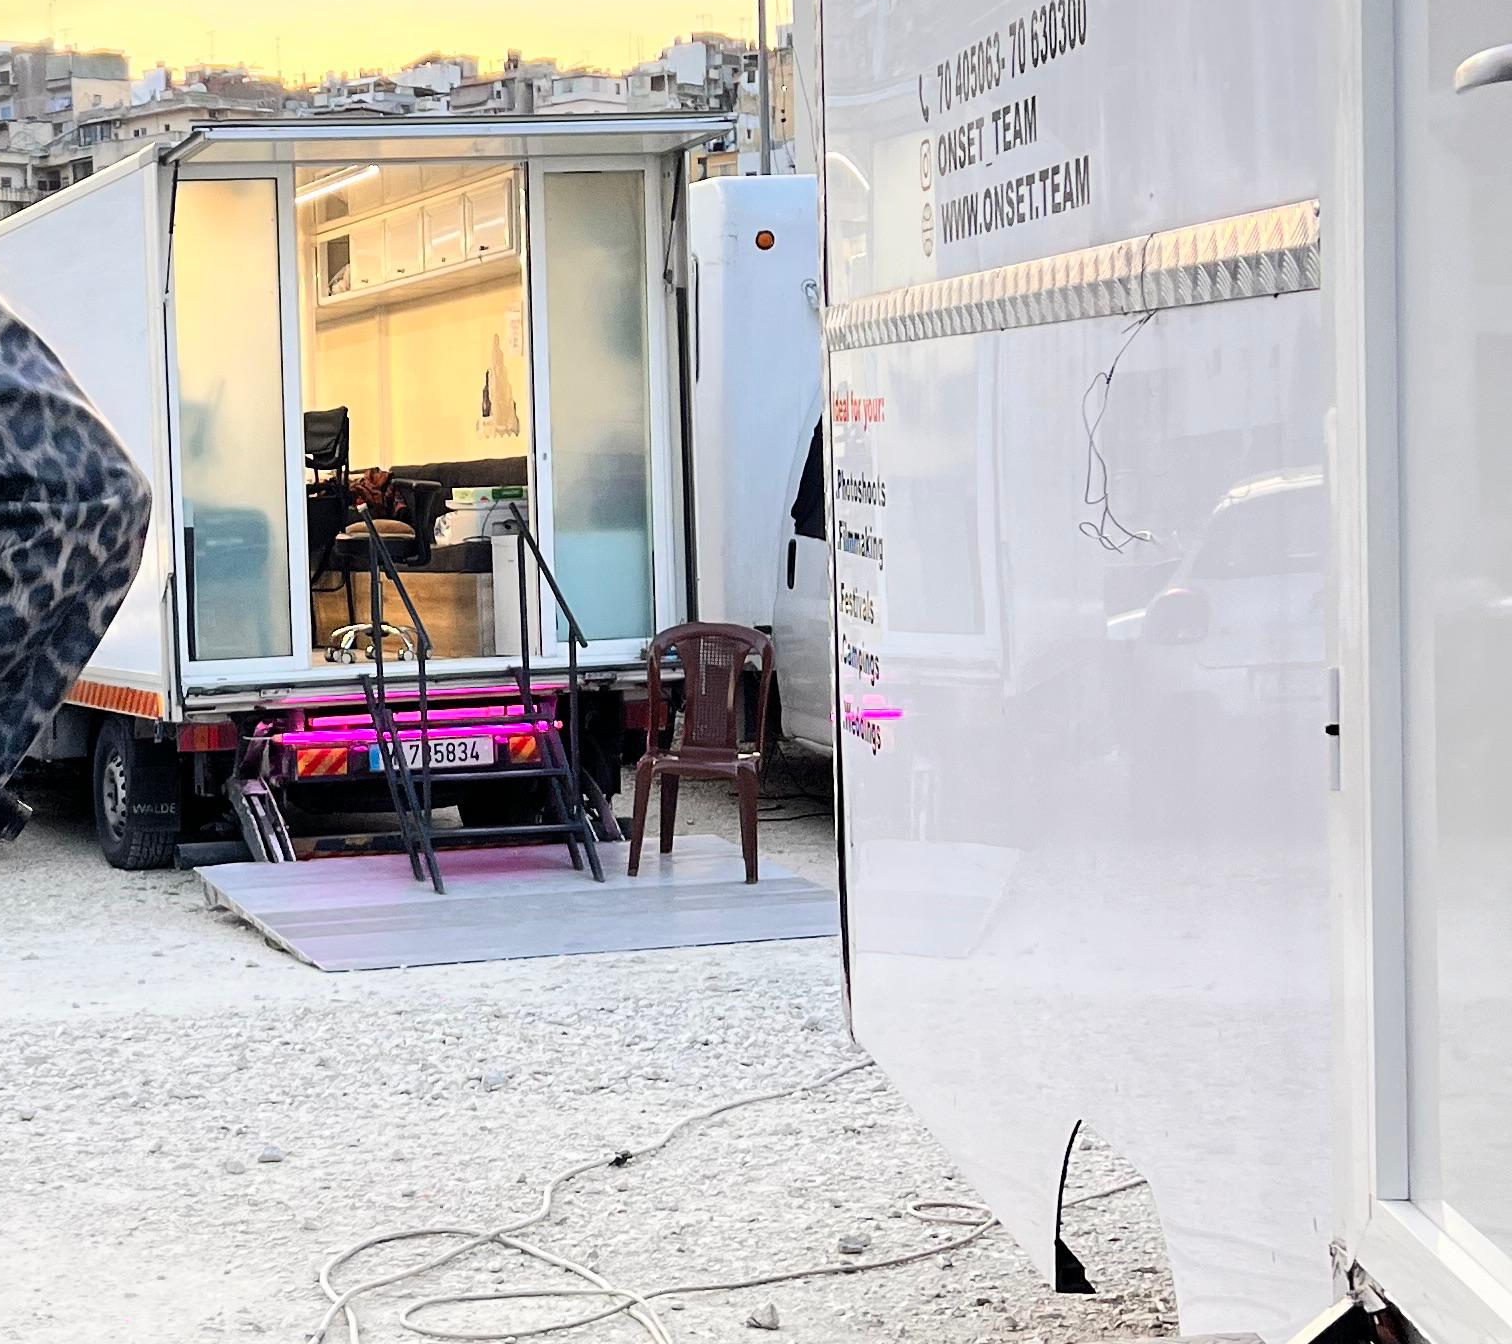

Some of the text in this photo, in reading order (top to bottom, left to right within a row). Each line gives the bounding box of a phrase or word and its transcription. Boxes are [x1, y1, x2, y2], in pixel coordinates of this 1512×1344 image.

[937, 59, 952, 114] 70
[1009, 17, 1026, 79] 70
[940, 154, 1091, 244] WWW.ONSET.TEAM
[851, 391, 861, 423] for
[862, 397, 886, 432] your:
[836, 469, 886, 507] Photoshoots
[839, 582, 875, 624] Festivals
[409, 740, 480, 766] 75834
